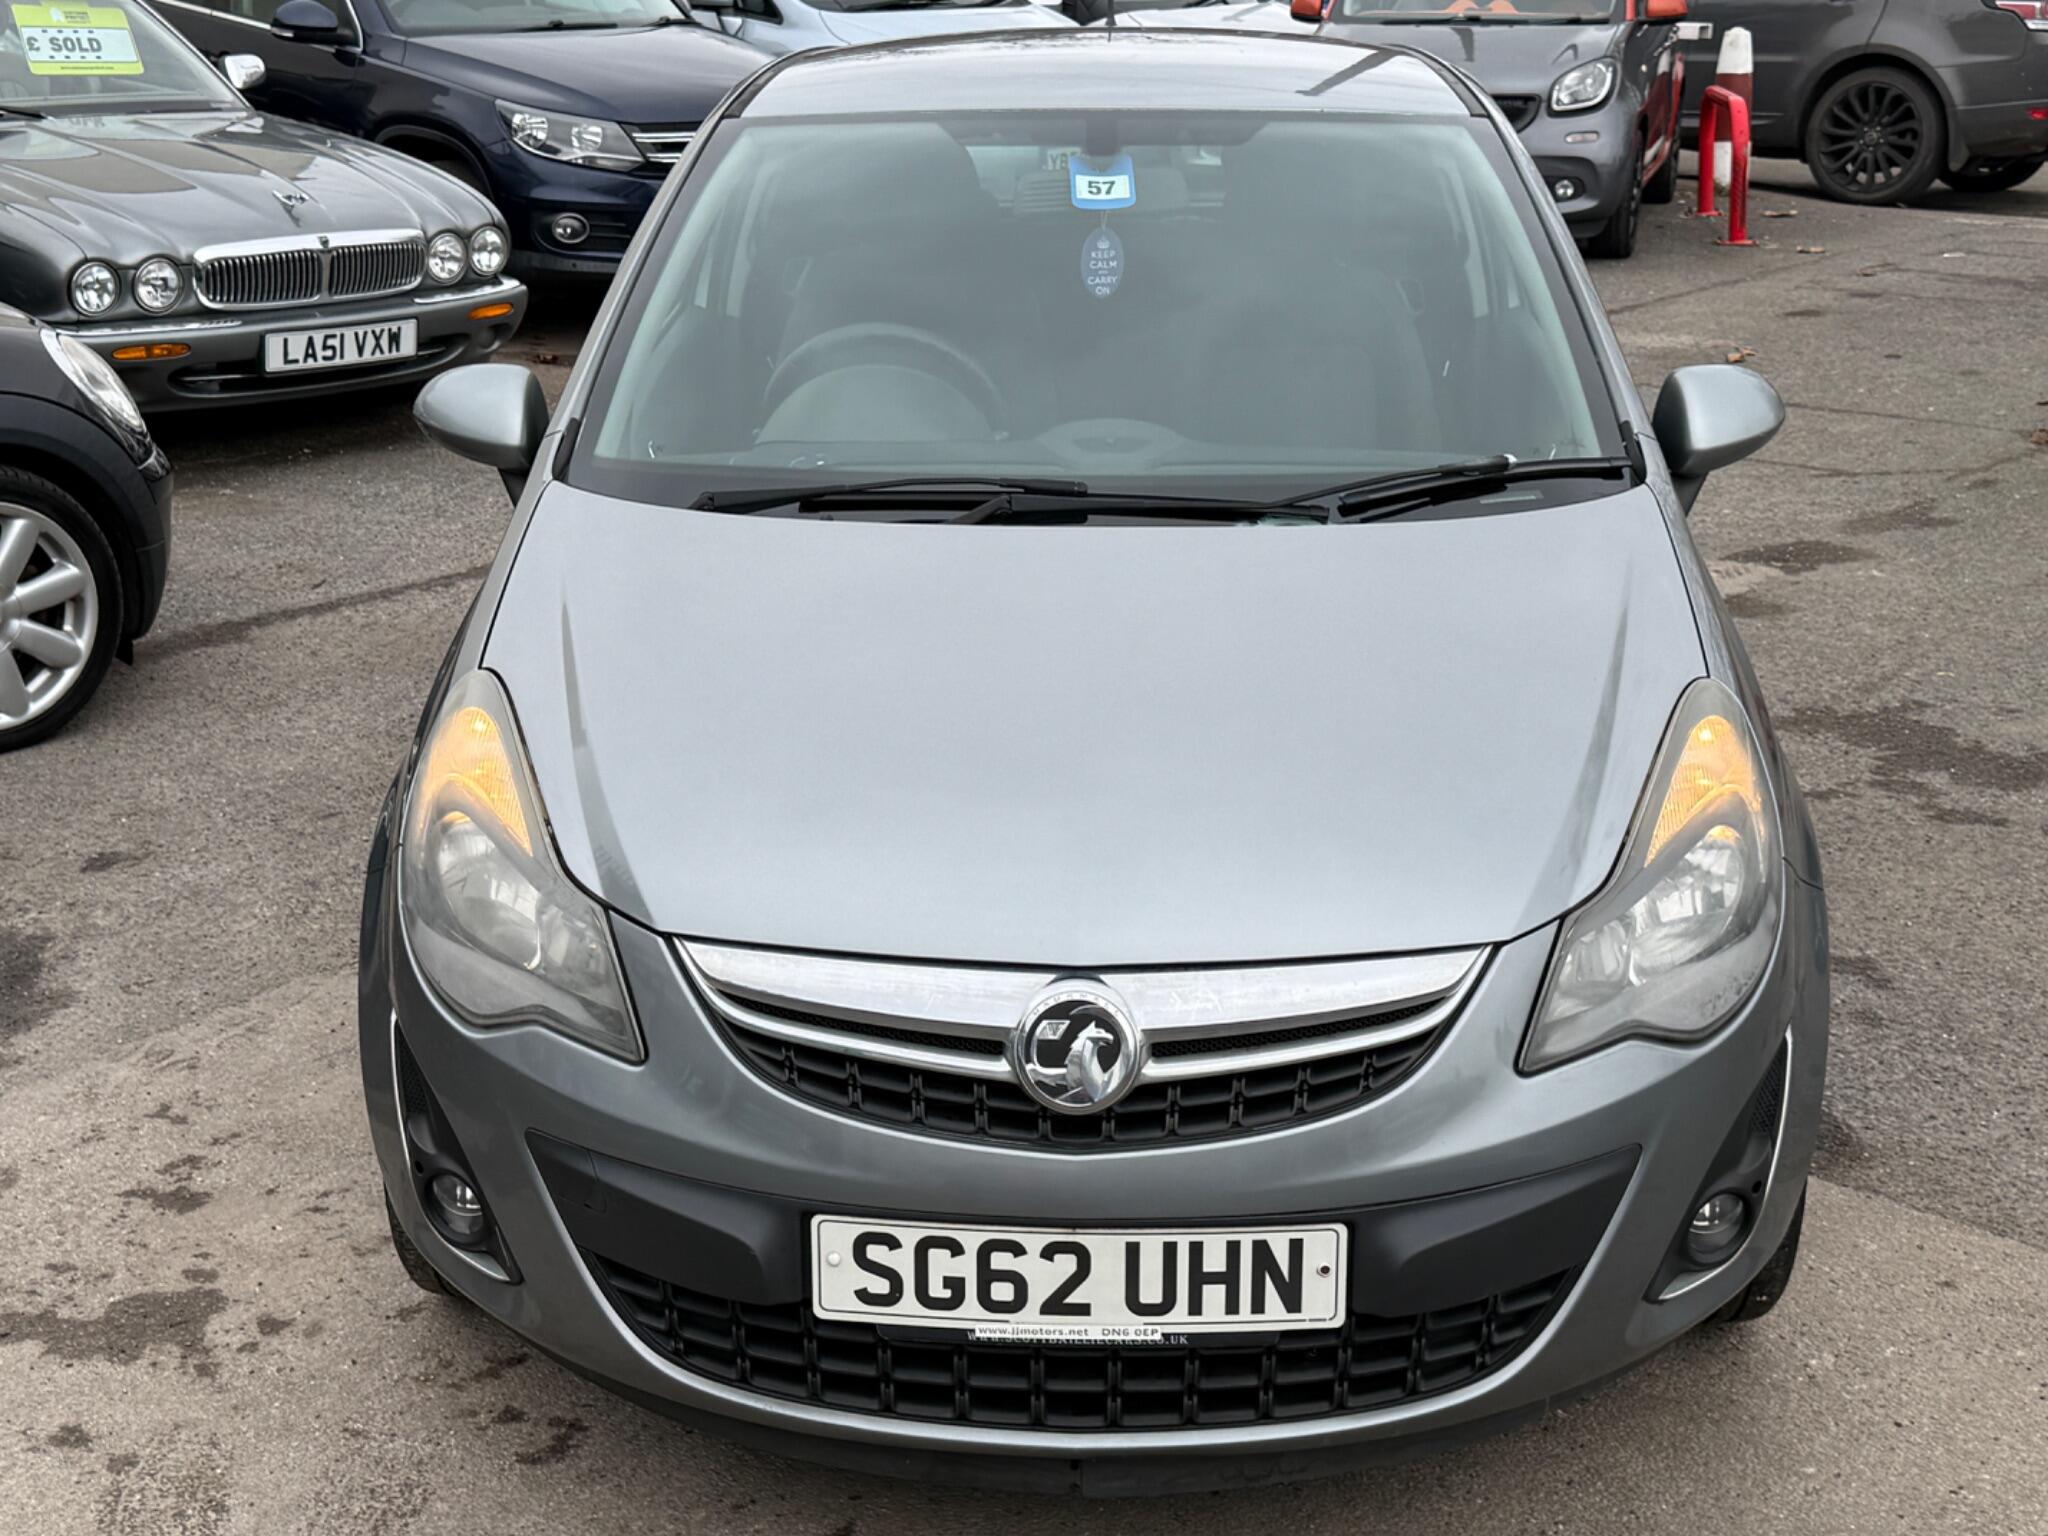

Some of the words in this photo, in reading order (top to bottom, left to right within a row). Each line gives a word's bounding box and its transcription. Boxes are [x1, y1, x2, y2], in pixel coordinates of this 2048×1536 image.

[26, 36, 41, 52] £
[48, 37, 103, 53] SOLD
[1087, 180, 1116, 196] 57
[1091, 250, 1116, 259] KEEP
[1089, 260, 1118, 269] CALM
[1087, 276, 1118, 285] CARRY
[1095, 286, 1110, 295] ON
[283, 333, 345, 365] LA51
[354, 326, 402, 358] VXW
[852, 1231, 1092, 1317] SG62
[1124, 1238, 1304, 1317] UHN
[1101, 1327, 1130, 1337] DN6
